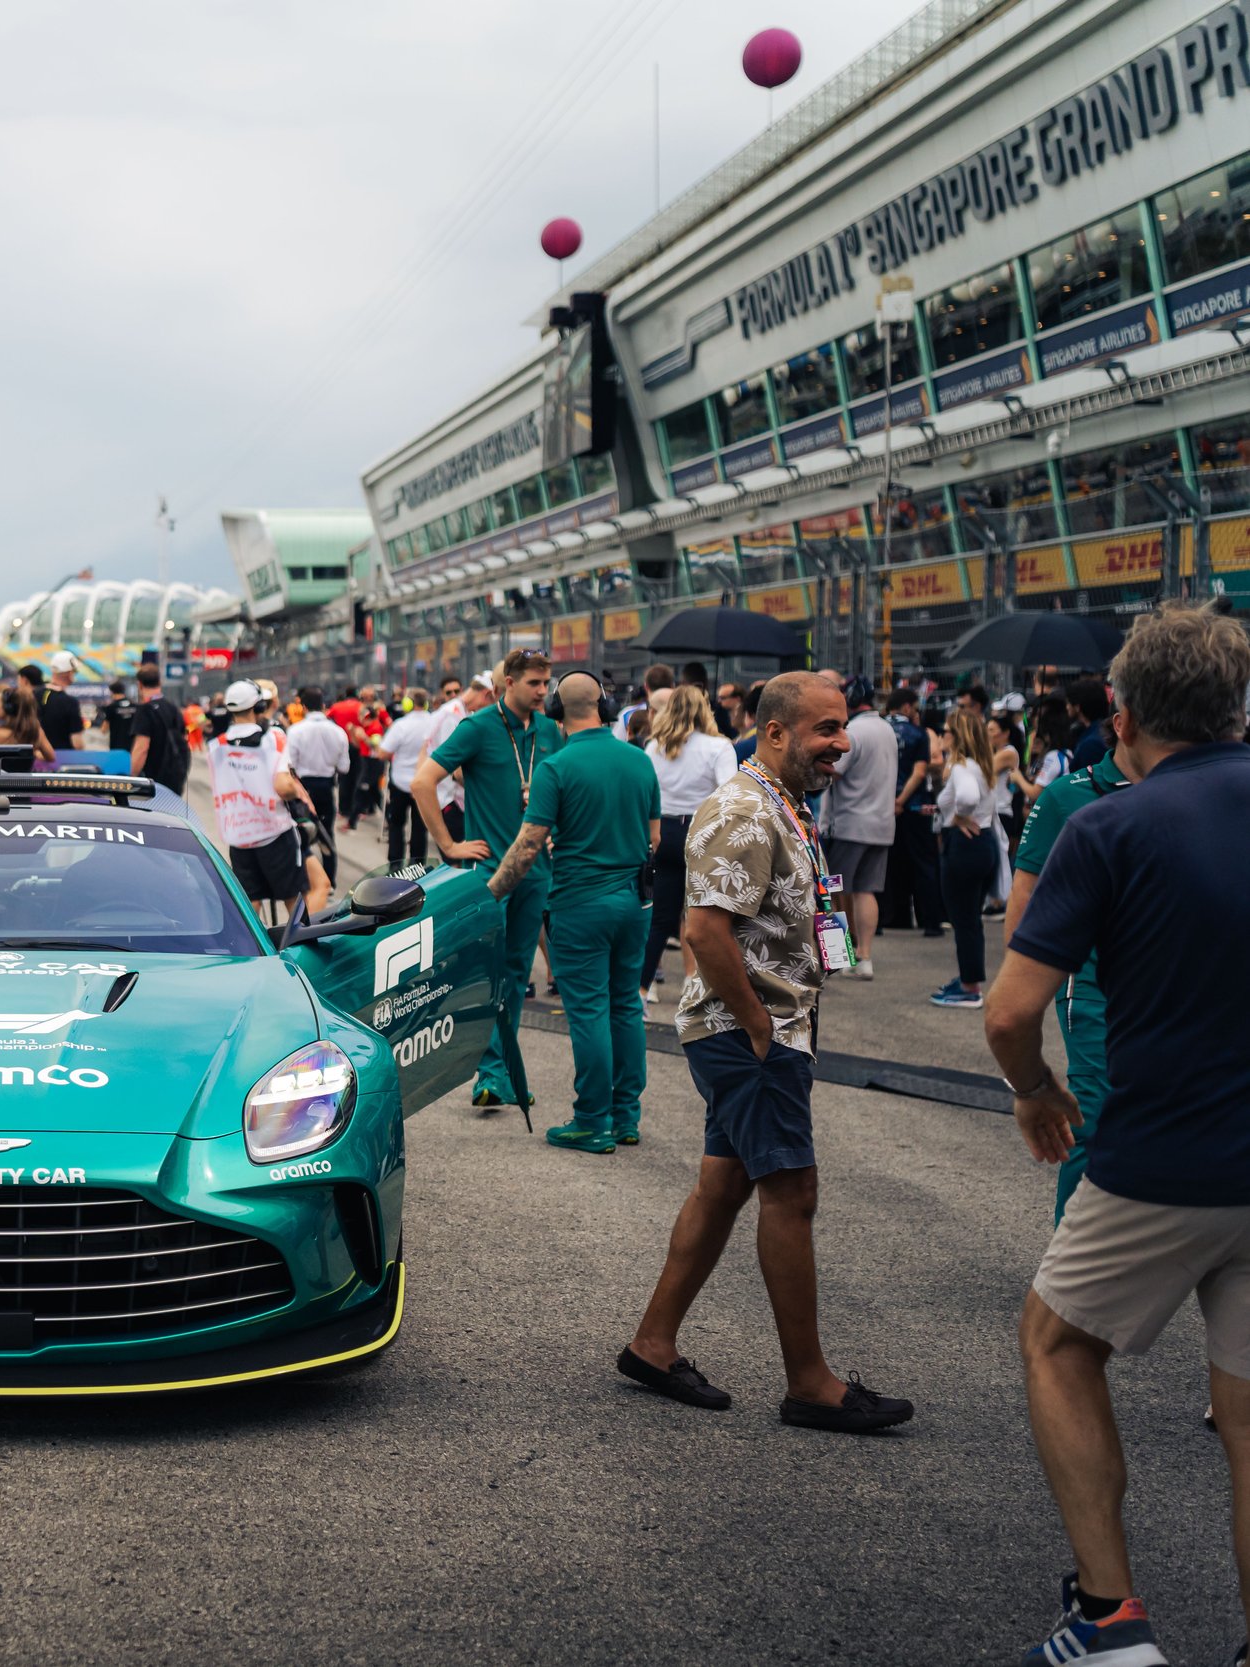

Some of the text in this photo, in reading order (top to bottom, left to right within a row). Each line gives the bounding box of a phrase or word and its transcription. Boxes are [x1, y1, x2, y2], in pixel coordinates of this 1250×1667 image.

[736, 242, 840, 340] FORMULA
[865, 127, 1038, 275] SINGAPORE
[1034, 49, 1178, 186] GRAND
[1175, 0, 1250, 114] PR
[1173, 288, 1242, 329] SINGAPORE
[1042, 322, 1146, 372] SINGAPORE AIRLINES
[902, 574, 943, 598] DHL
[38, 962, 127, 972] CAR
[393, 995, 403, 1008] FIA
[403, 984, 426, 1002] Formula
[373, 997, 393, 1030] FIA
[393, 1002, 411, 1019] World
[393, 1014, 454, 1067] ramco
[32, 1167, 86, 1184] CAR
[270, 1160, 332, 1181] aramco
